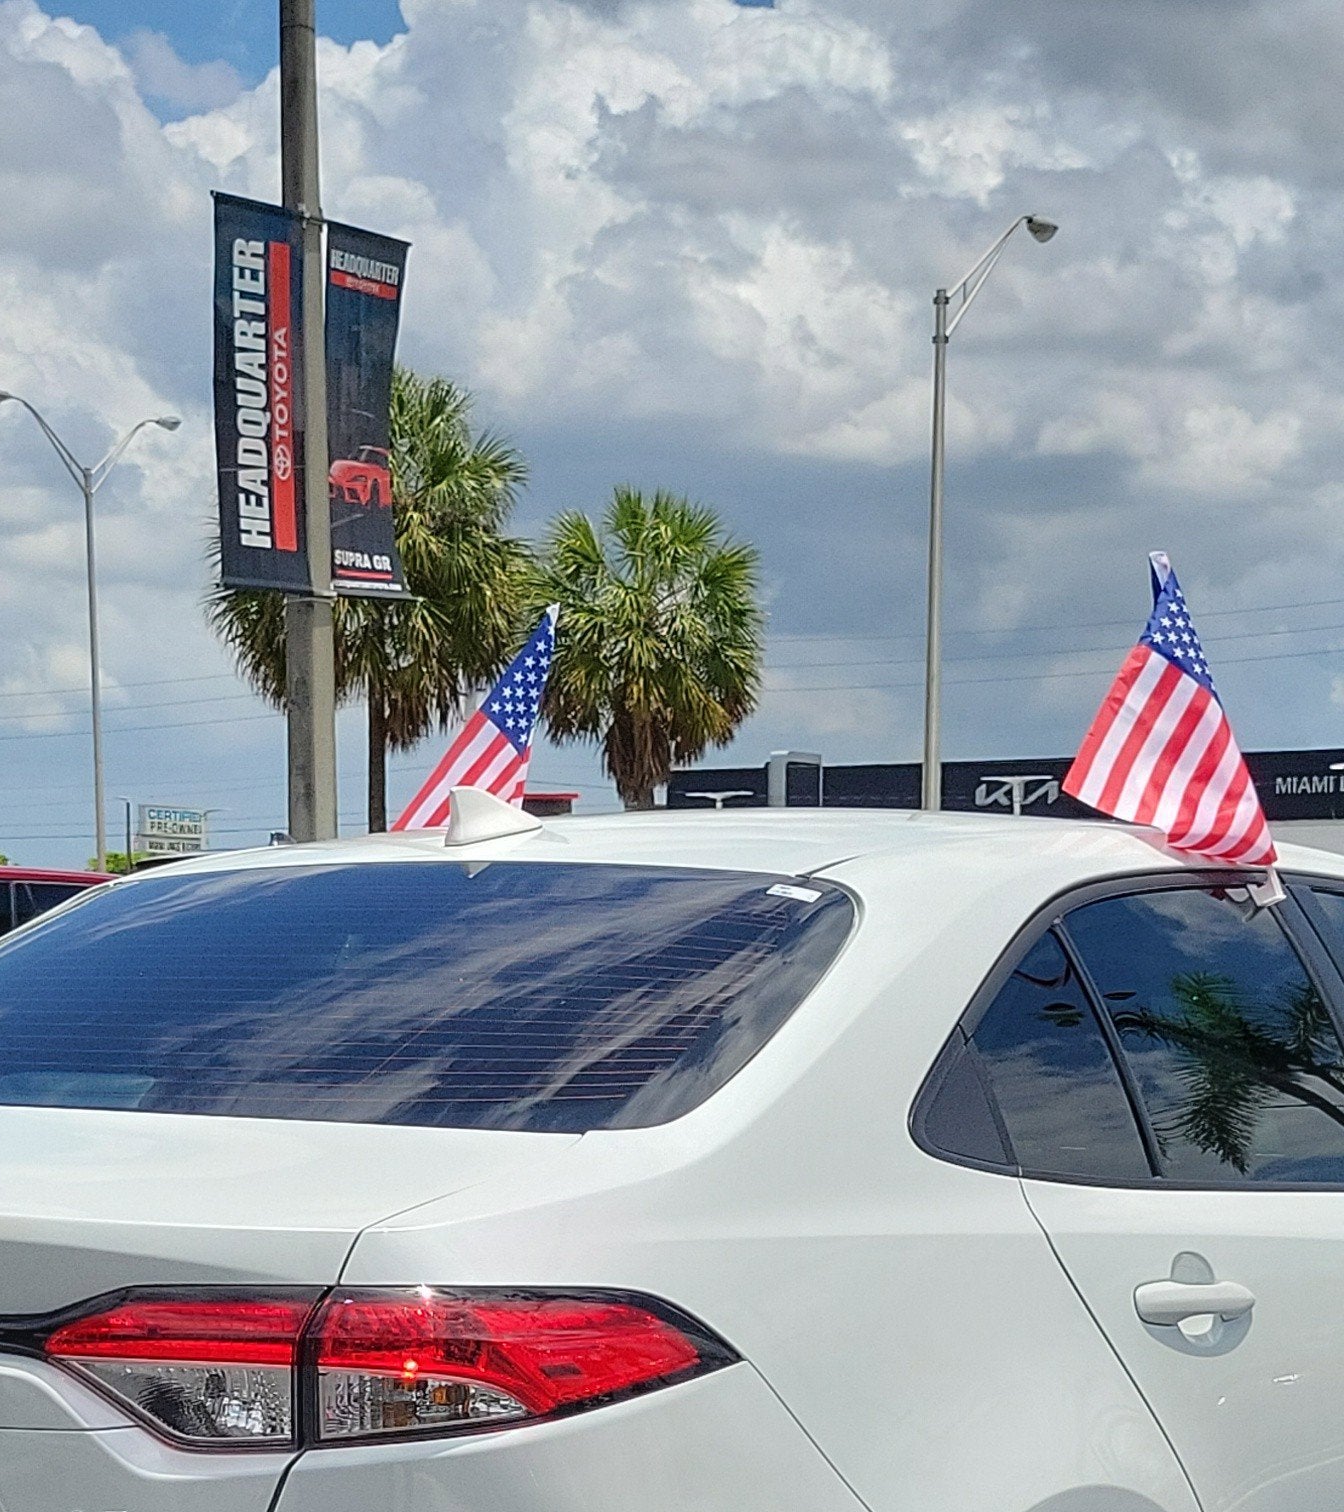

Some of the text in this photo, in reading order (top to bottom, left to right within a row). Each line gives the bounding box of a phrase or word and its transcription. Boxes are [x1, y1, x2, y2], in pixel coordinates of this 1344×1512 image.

[330, 249, 399, 285] HEADQUARTER
[232, 238, 272, 549] HEADQUARTER
[272, 326, 289, 441] TOYOTA
[334, 549, 392, 571] SUPRA GR
[1275, 775, 1337, 794] MIAMI
